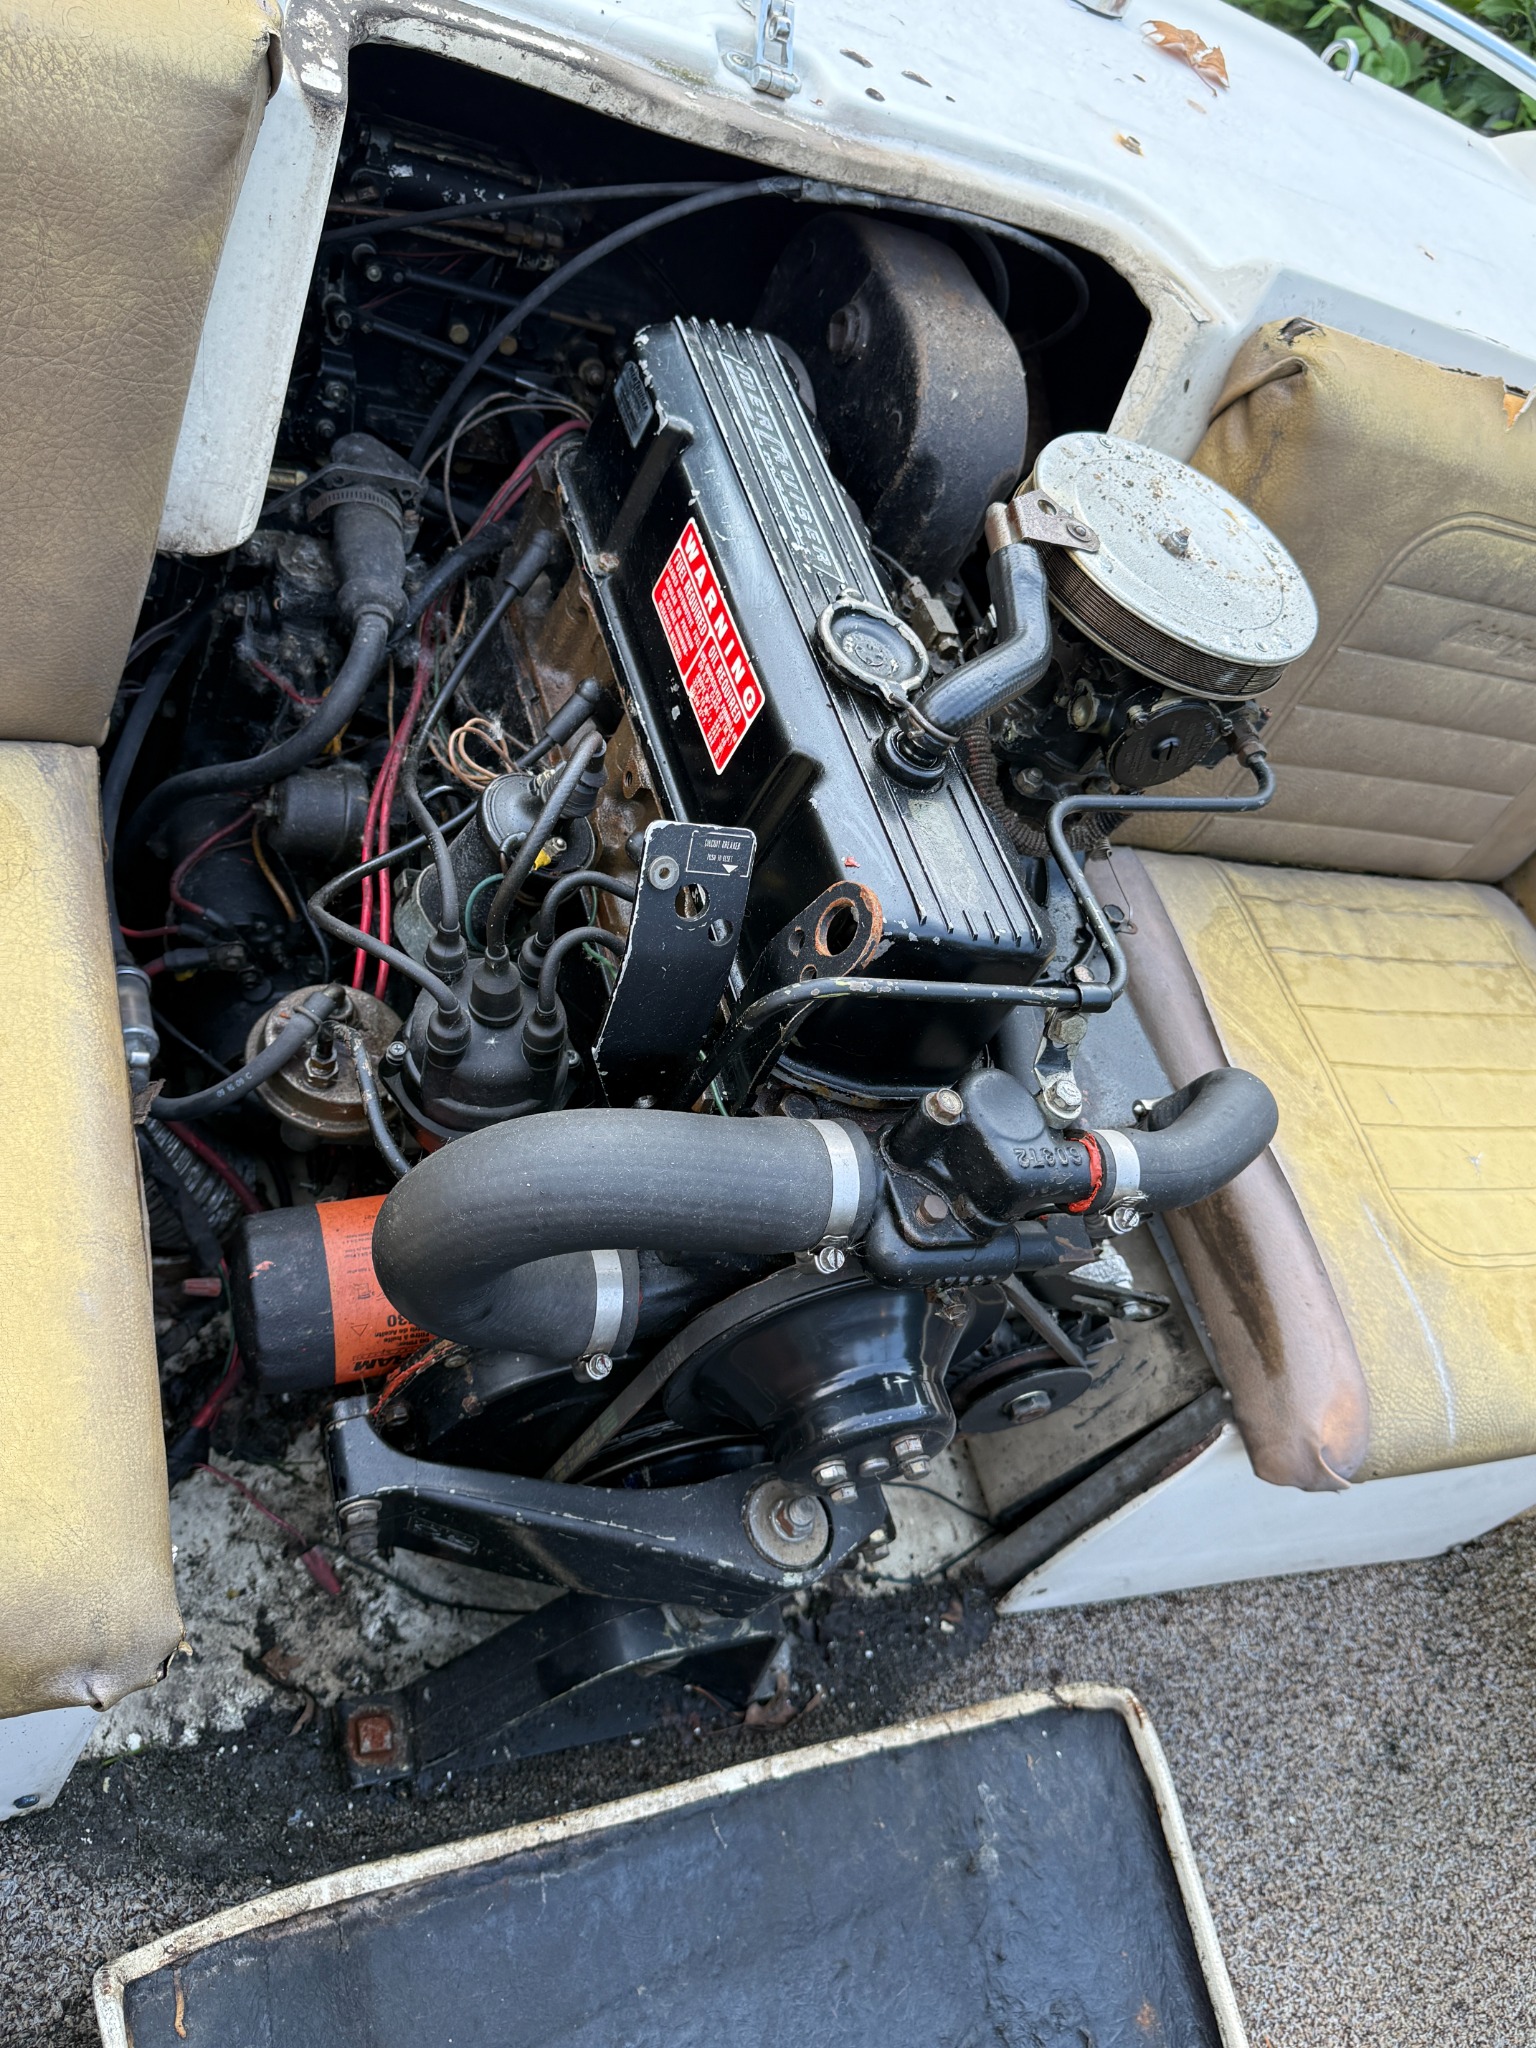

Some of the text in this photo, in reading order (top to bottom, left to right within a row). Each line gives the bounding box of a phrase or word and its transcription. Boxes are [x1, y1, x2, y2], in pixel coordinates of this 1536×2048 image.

[672, 551, 707, 638] FUEL REQUIRED
[685, 533, 755, 712] WARNING
[707, 643, 741, 726] OIL REQUIRED
